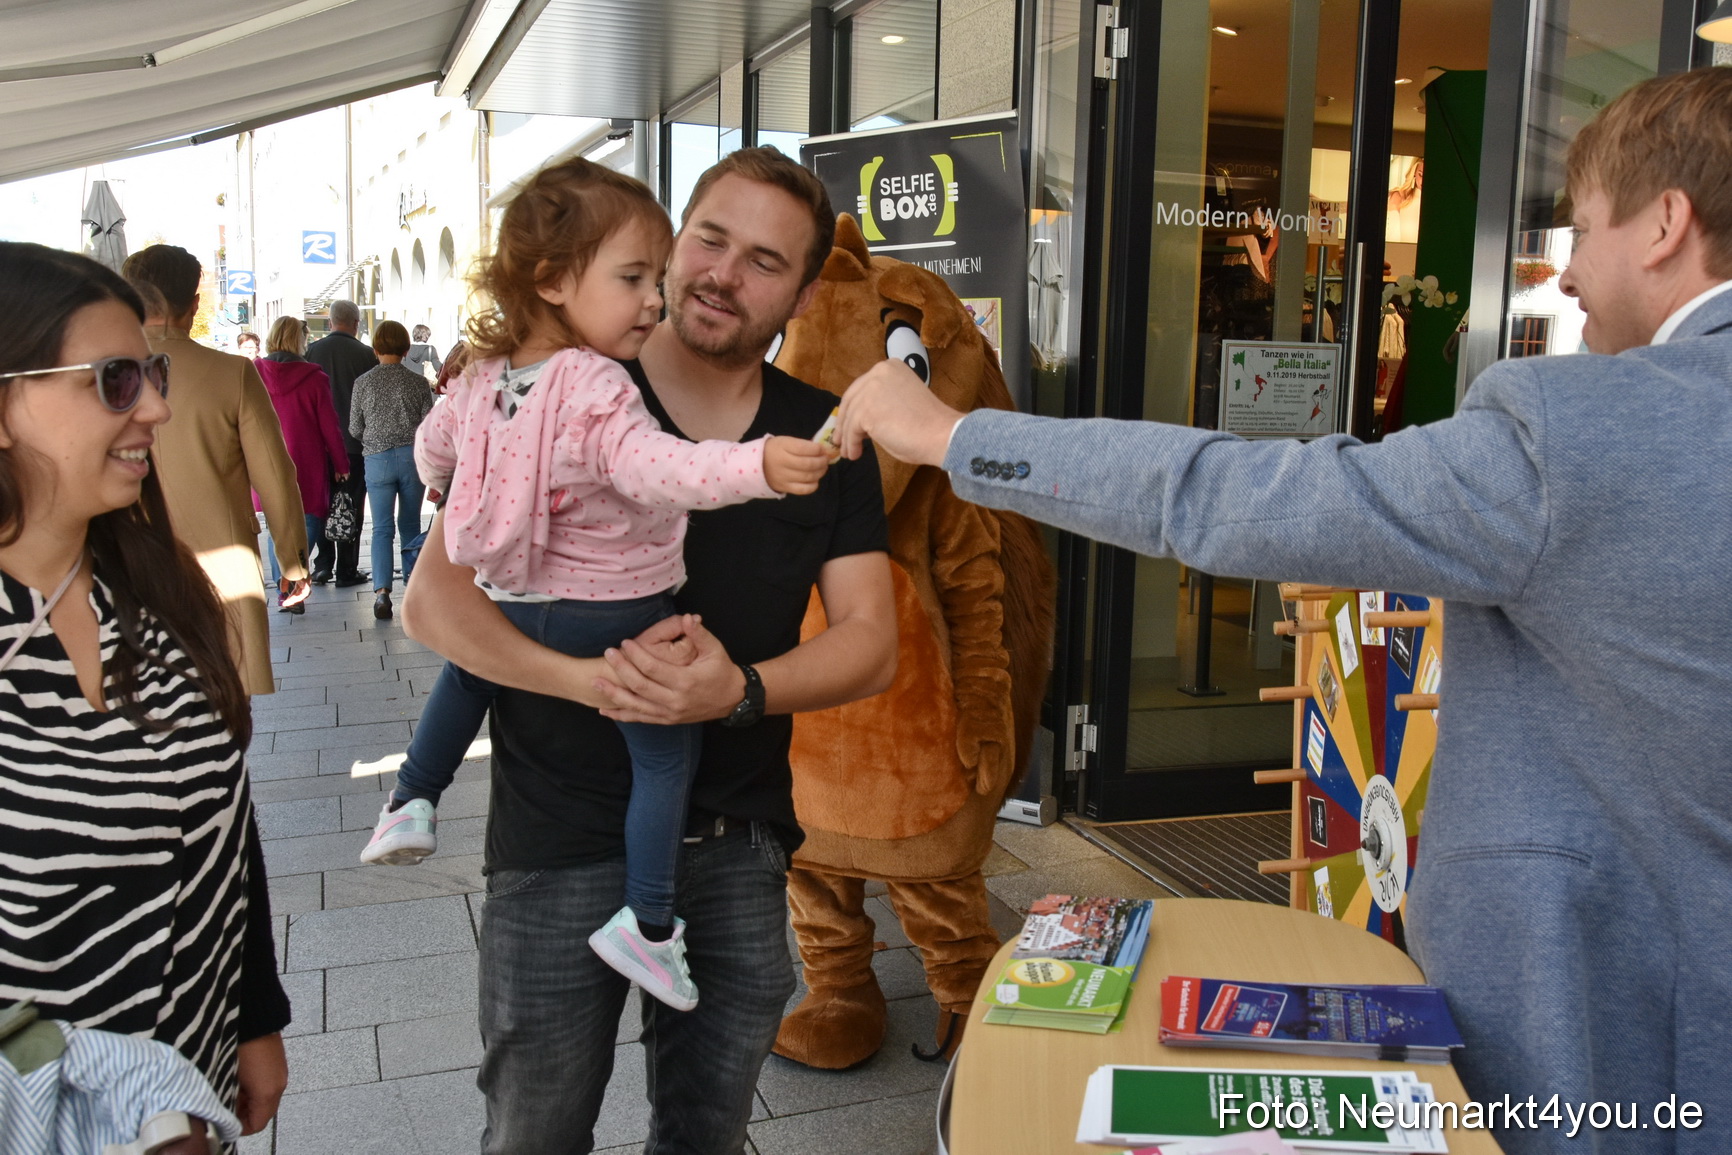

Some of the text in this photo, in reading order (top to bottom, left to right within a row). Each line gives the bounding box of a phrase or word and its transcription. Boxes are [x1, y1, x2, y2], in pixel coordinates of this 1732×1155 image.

[880, 173, 935, 195] SELFIE
[880, 194, 930, 221] BOX
[1156, 202, 1343, 234] Modern Women
[1260, 349, 1314, 359] Tanzen wie in
[1266, 371, 1331, 380] 9.11.2019 Herbstball
[1077, 968, 1106, 1008] NEUMARKT
[1289, 1077, 1305, 1096] des
[1308, 1077, 1325, 1096] Die
